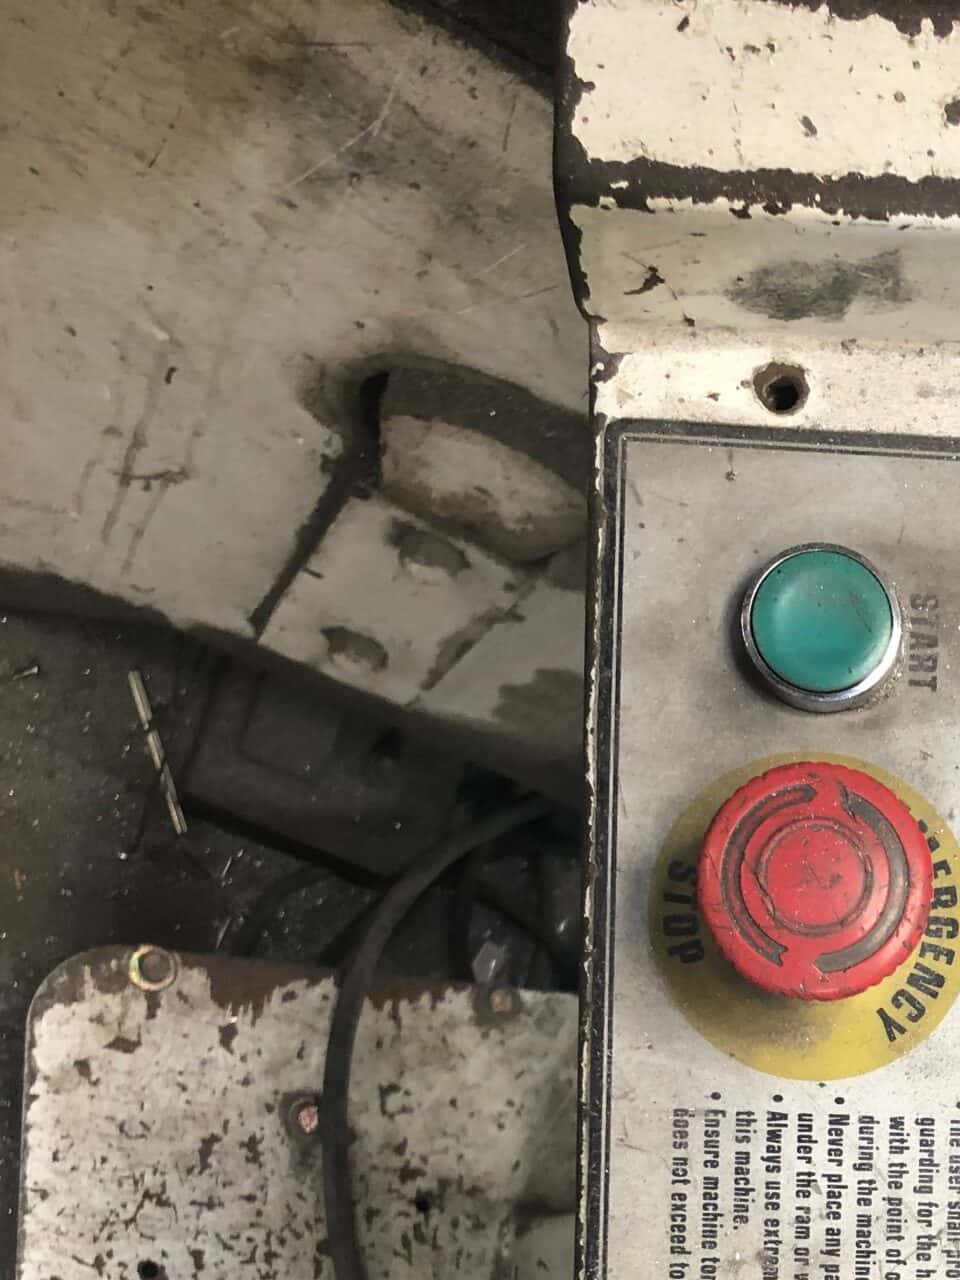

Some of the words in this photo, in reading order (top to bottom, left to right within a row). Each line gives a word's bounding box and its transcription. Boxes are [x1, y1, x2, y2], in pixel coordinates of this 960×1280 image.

[908, 593, 939, 693] START
[663, 860, 704, 964] STOP
[672, 1108, 695, 1149] does
[704, 1108, 726, 1168] Ensure
[735, 1111, 757, 1143] this
[761, 1111, 788, 1173] Always
[797, 1112, 817, 1164] under
[826, 1114, 849, 1166] Never
[853, 1115, 879, 1172] during
[889, 1116, 909, 1154] with
[672, 1157, 693, 1185] not
[888, 1162, 908, 1190] the
[914, 1118, 937, 1194] guarding
[732, 1151, 755, 1230] machine.
[763, 1181, 783, 1211] use
[795, 1171, 816, 1199] the
[822, 1173, 846, 1220] place
[856, 1179, 878, 1207] the
[670, 1192, 691, 1254] exceed
[701, 1176, 724, 1250] machine
[794, 1206, 811, 1239] ram
[882, 1197, 906, 1242] point
[916, 1201, 936, 1227] for
[794, 1247, 811, 1266] or
[821, 1227, 842, 1257] any
[886, 1249, 906, 1266] of
[916, 1234, 935, 1261] the
